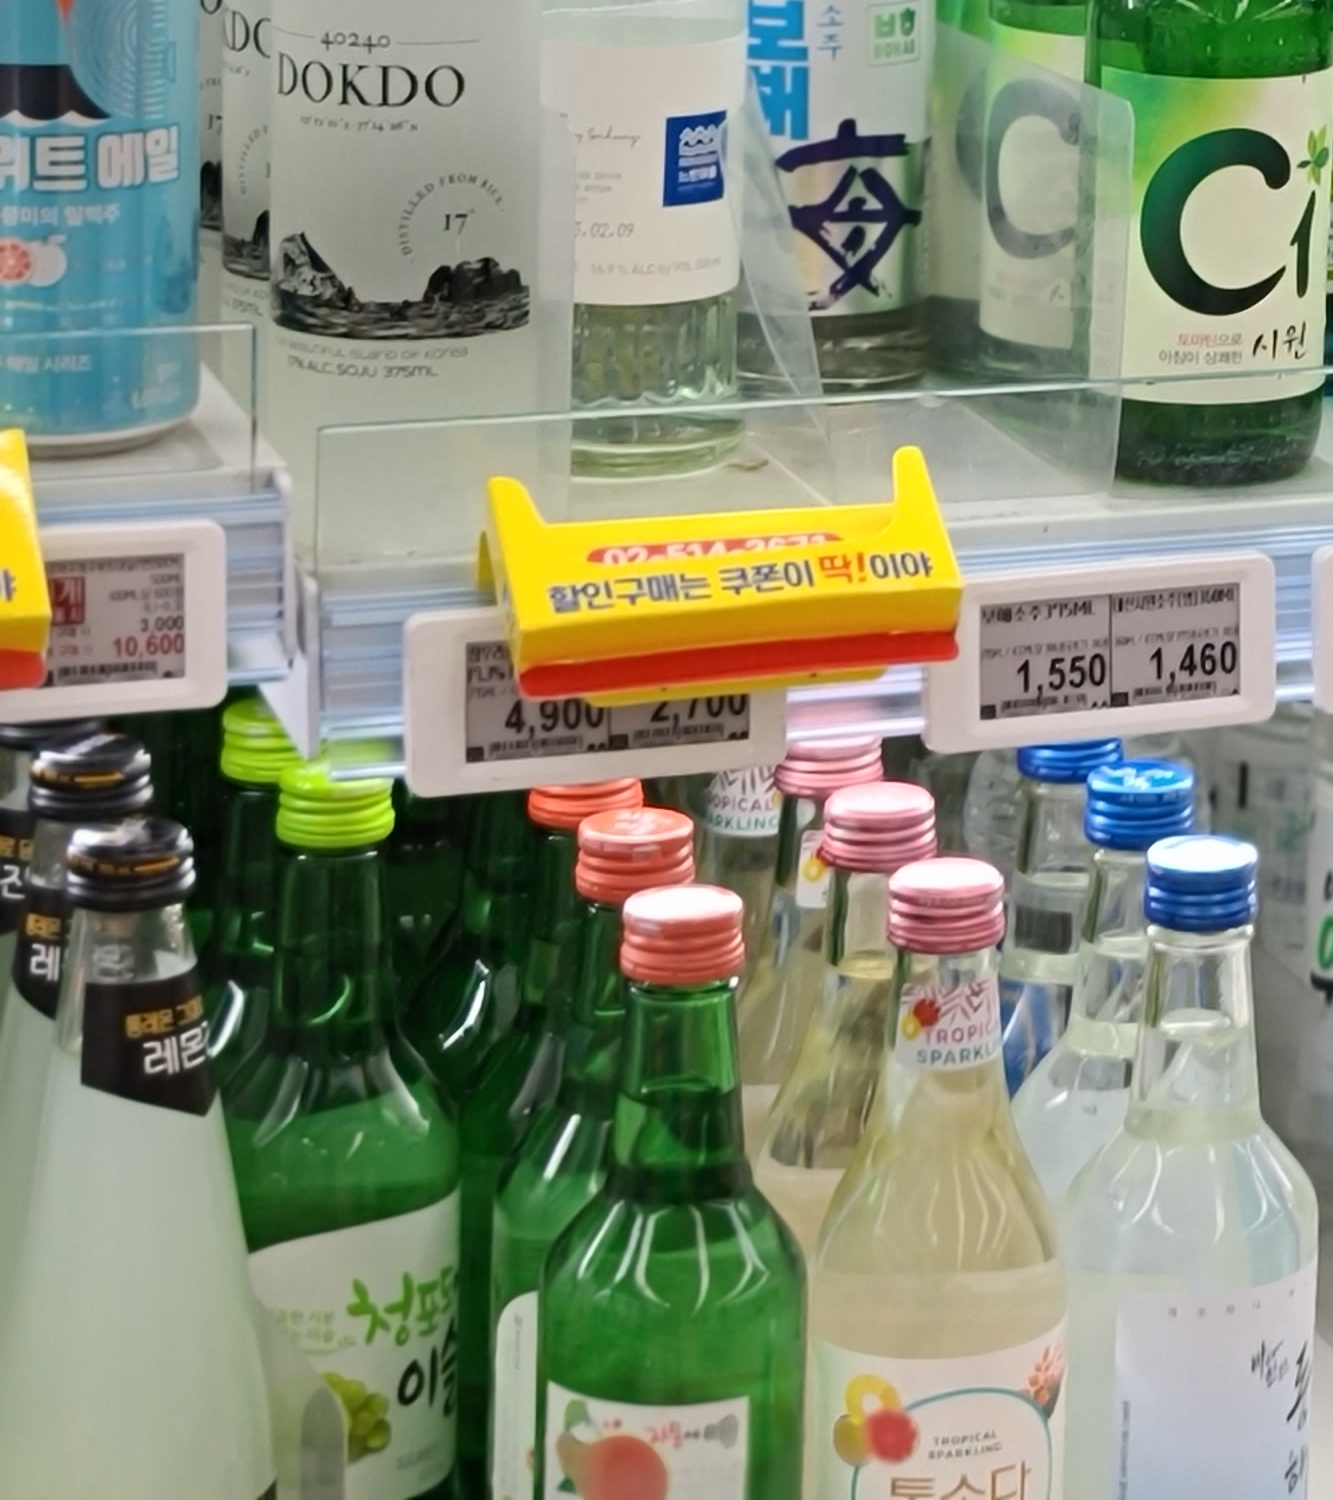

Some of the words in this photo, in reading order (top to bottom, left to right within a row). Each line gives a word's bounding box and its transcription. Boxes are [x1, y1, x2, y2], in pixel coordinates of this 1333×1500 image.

[320, 30, 392, 54] 40240
[276, 51, 466, 108] DOKDO
[97, 124, 179, 188] 에일
[1252, 320, 1307, 361] 시원
[547, 570, 712, 613] 할인구매는
[718, 559, 814, 596] 쿠폰이
[113, 633, 185, 658] 10,600
[1149, 640, 1238, 690] 1,460
[1016, 653, 1107, 702] 1,550
[504, 698, 604, 740] 4,900
